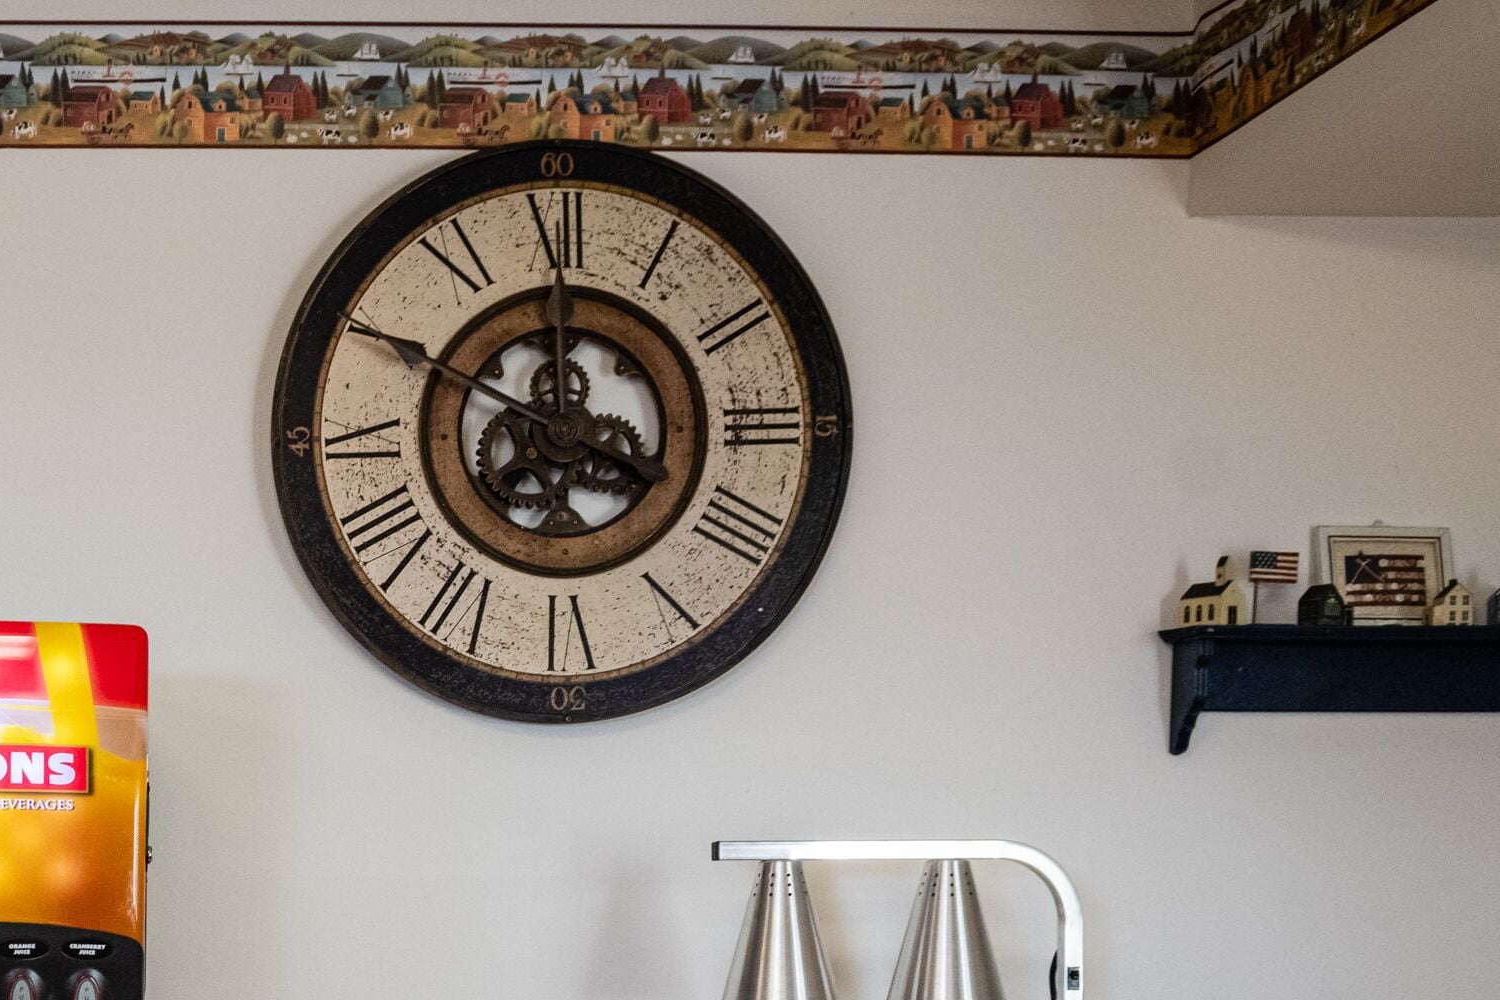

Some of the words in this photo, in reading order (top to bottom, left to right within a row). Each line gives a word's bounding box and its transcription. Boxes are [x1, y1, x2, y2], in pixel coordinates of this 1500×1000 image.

[541, 152, 574, 177] 60
[526, 191, 584, 272] XII
[815, 414, 839, 437] 15
[287, 426, 310, 458] 45
[550, 685, 587, 711] 30
